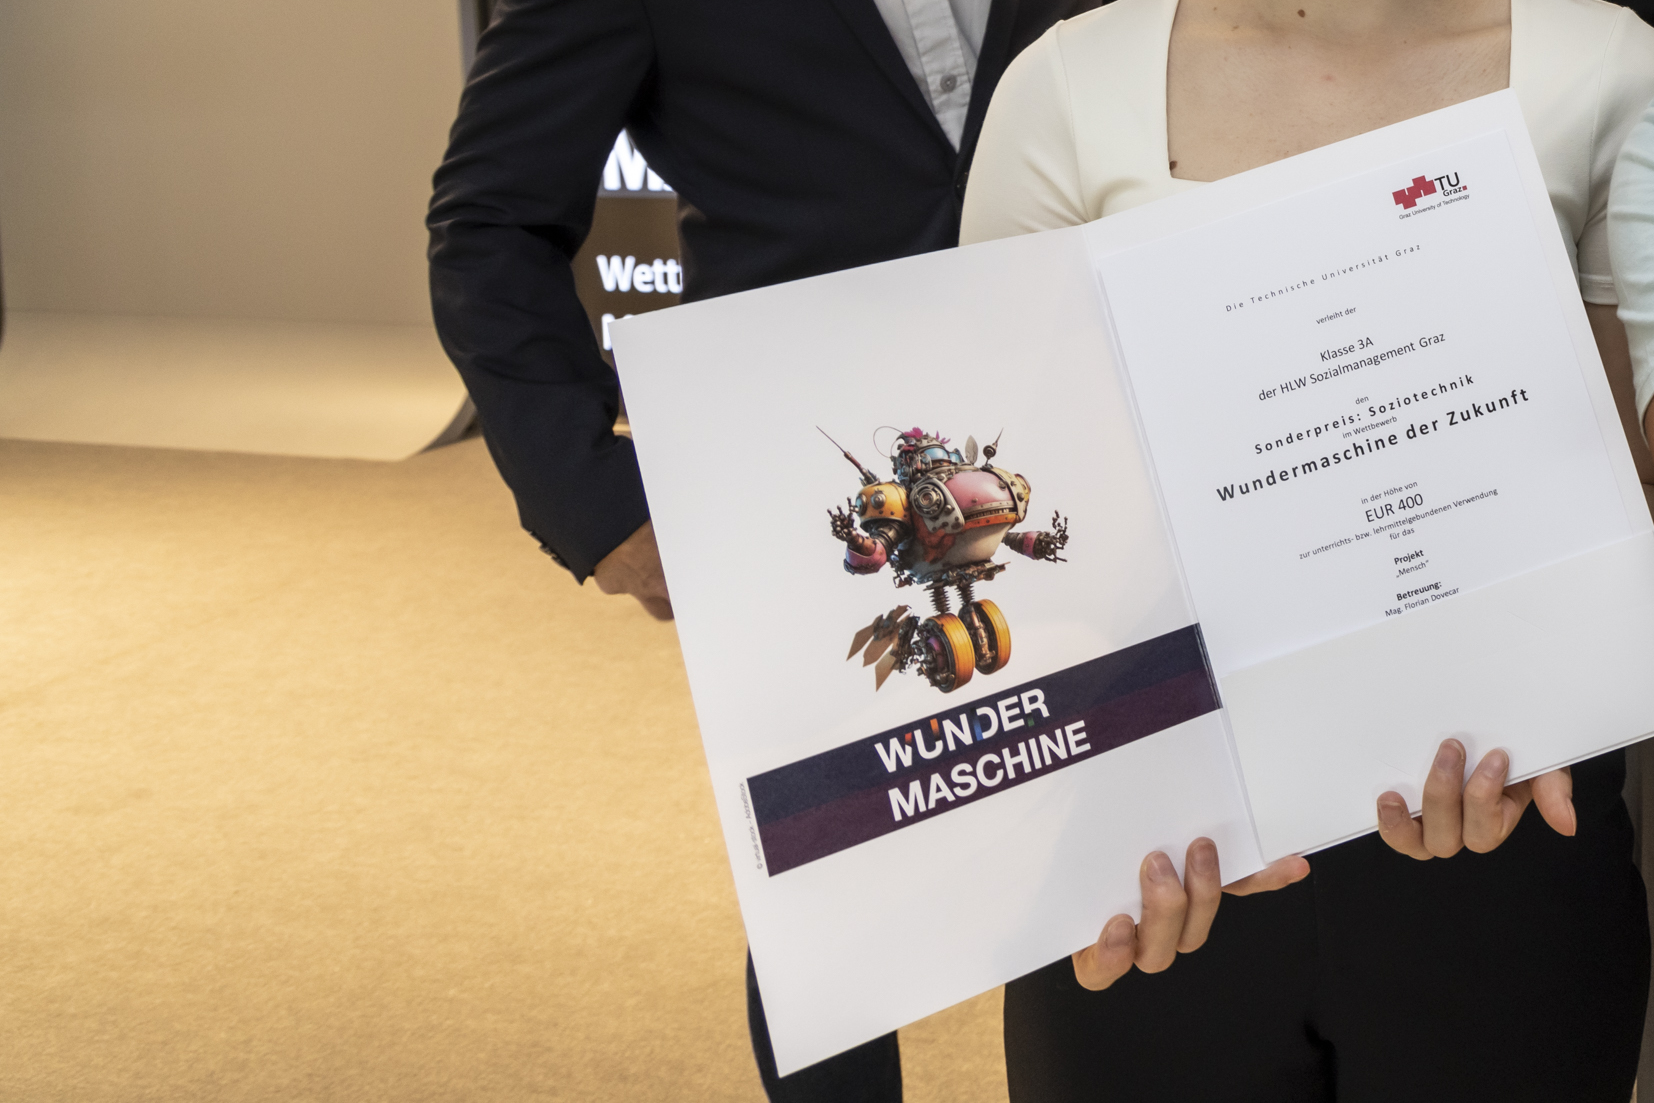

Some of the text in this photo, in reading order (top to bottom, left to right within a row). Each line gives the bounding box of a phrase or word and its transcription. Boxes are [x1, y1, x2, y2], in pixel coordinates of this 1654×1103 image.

[1434, 172, 1461, 191] TU
[1442, 186, 1463, 198] Graz
[1398, 212, 1412, 221] Graz
[1411, 205, 1437, 216] University
[1442, 194, 1471, 206] Technology
[1225, 244, 1421, 313] Die Technische Universität Graz
[1316, 306, 1358, 325] verleiht der
[1320, 337, 1375, 363] Klasse 3A
[1258, 333, 1446, 402] der HLW Sozialmanagement Graz
[1355, 396, 1370, 406] den
[1254, 374, 1475, 455] Sonderpreis: Soziotechnik
[1342, 416, 1398, 440] im Wettbewerb
[1216, 389, 1529, 502] Wundermaschine der Zukunft
[1370, 493, 1383, 503] der
[1383, 486, 1404, 498] Höhe
[1404, 481, 1419, 491] von
[1365, 493, 1424, 523] EUR 400
[1299, 489, 1499, 561] zur unterrichts- bzw. lehrmittelgebundenen Verwendung
[1389, 528, 1416, 541] für das
[1393, 549, 1425, 566] Projekt
[1385, 587, 1460, 617] Mag. Florian Dovecar
[1396, 581, 1443, 602] Betreuung:
[874, 687, 1051, 774] WUNDER
[887, 719, 1092, 822] MASCHINE
